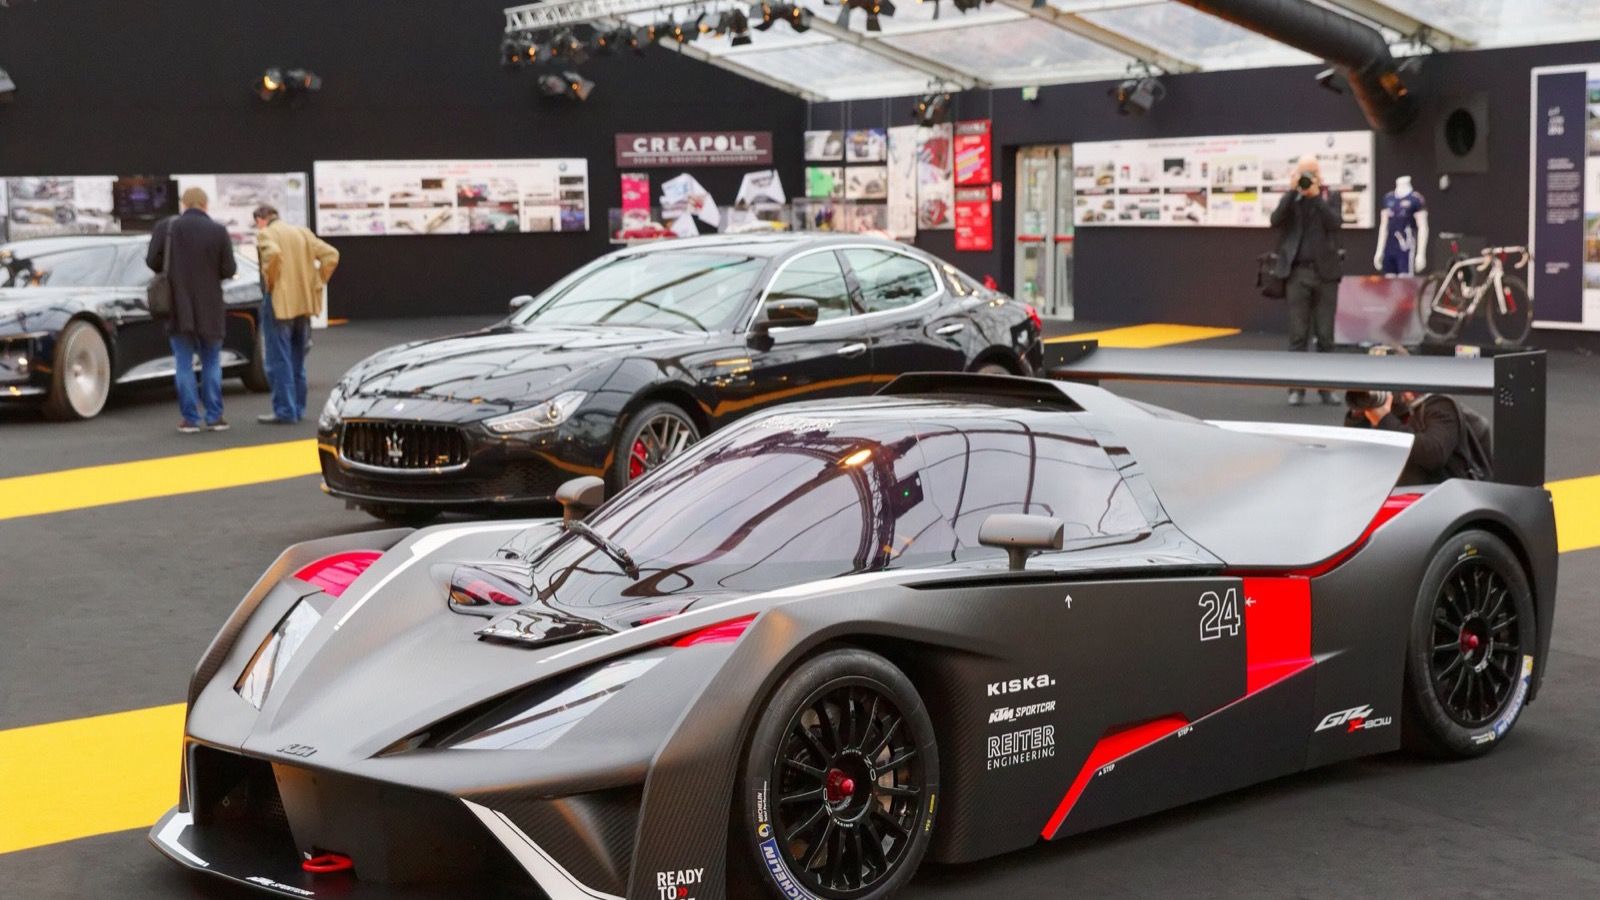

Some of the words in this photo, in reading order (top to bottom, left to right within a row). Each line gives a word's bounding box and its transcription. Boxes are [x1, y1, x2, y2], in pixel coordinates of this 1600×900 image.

[632, 135, 757, 153] CREAPOLE
[1198, 587, 1241, 641] 24
[987, 724, 1056, 759] REITER
[987, 746, 1056, 771] ENGINEERING
[1102, 763, 1116, 775] STEP
[656, 867, 705, 888] READY
[763, 846, 808, 900] ICHELIN
[657, 885, 678, 900] TO
